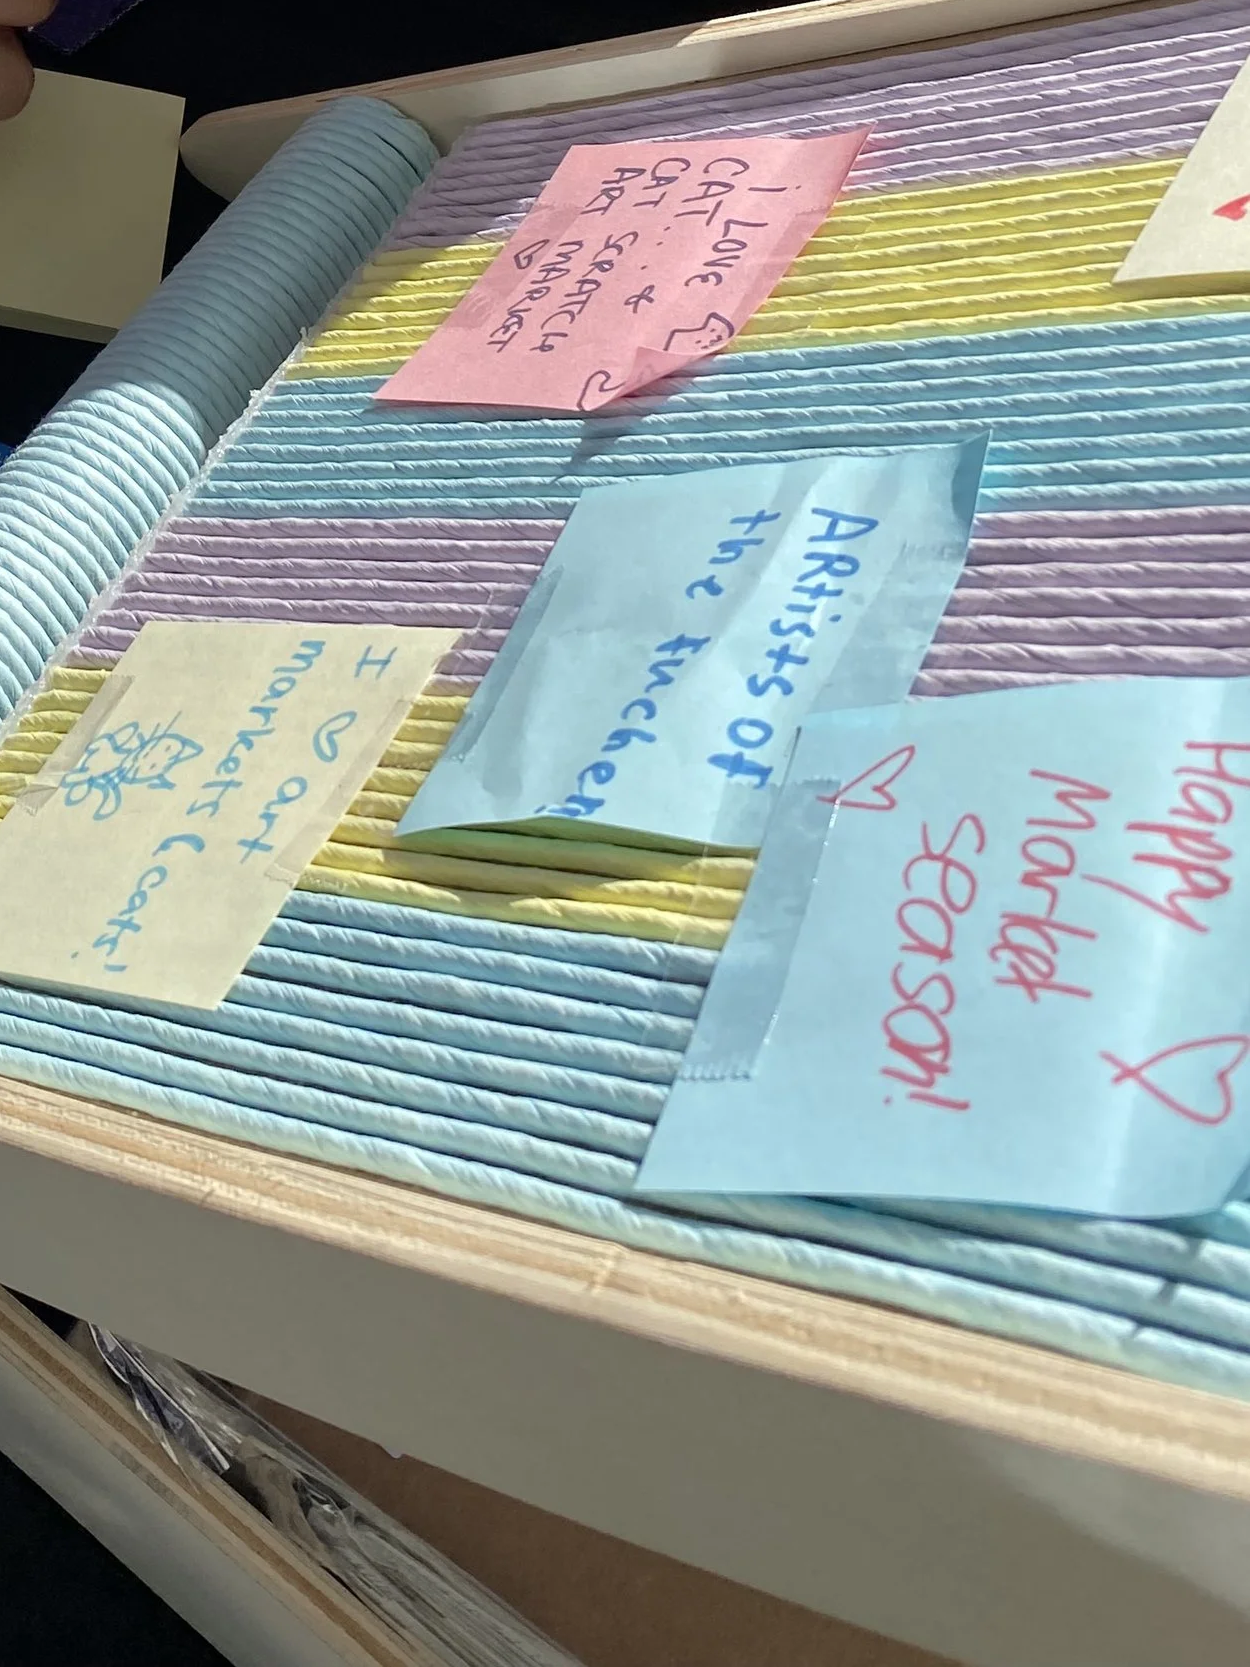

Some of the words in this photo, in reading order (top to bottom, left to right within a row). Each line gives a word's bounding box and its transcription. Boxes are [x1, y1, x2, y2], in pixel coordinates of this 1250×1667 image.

[581, 166, 646, 217] ART
[632, 156, 692, 210] CAT
[684, 216, 770, 288] LOVE
[685, 508, 782, 601] the
[353, 644, 399, 680] I
[186, 639, 328, 820] markets
[236, 775, 310, 865] art
[1079, 741, 1250, 935] Happy
[988, 768, 1113, 1003] Market
